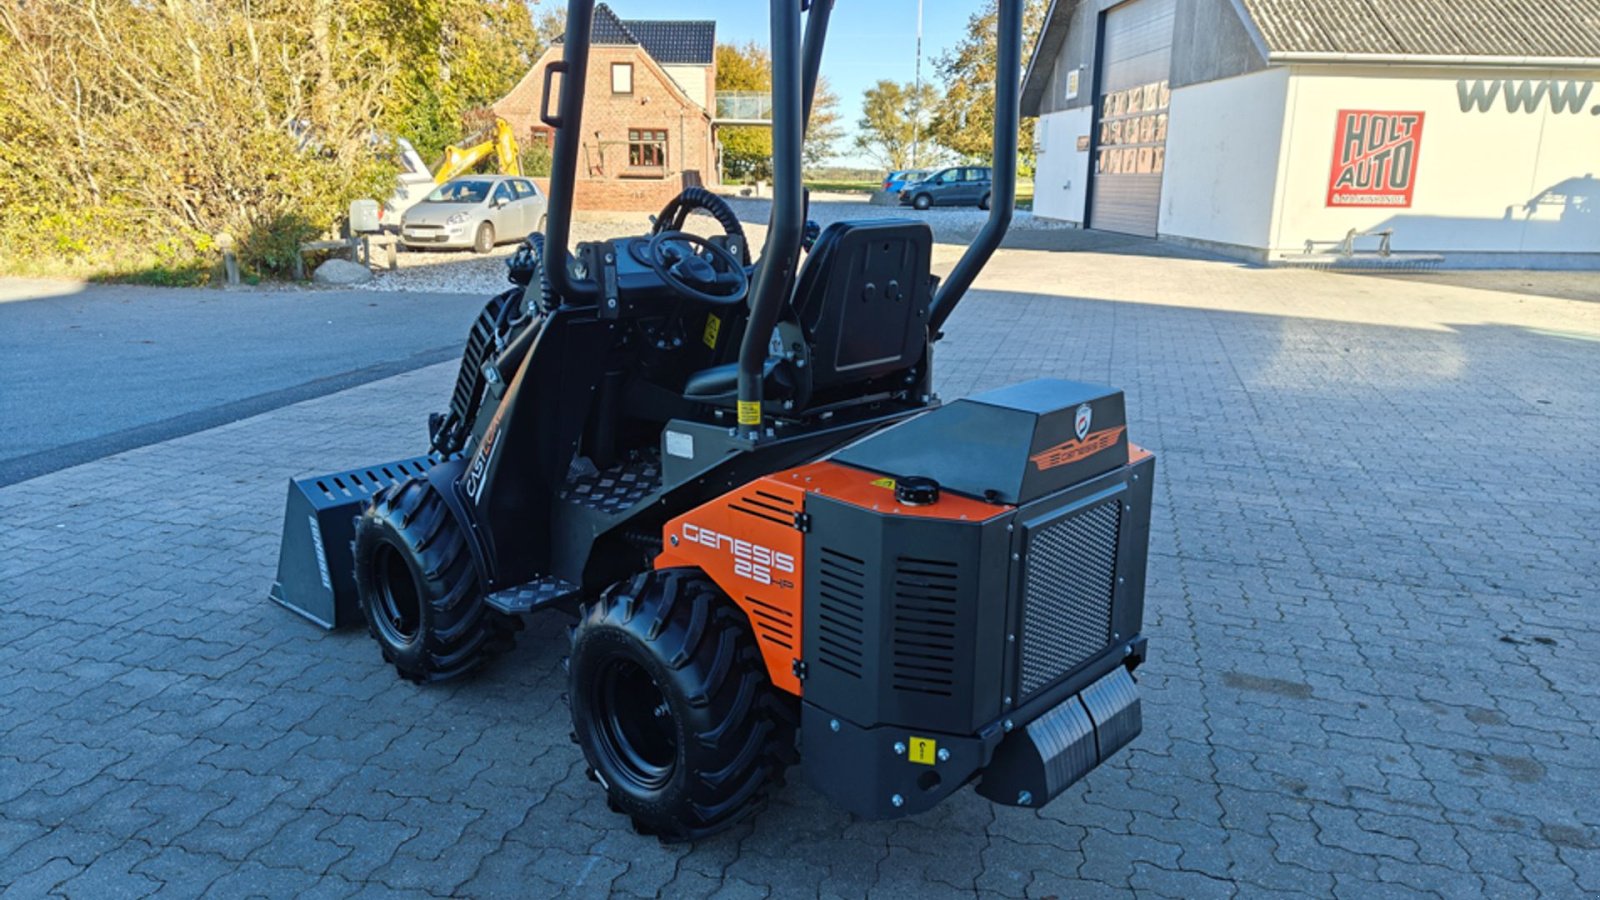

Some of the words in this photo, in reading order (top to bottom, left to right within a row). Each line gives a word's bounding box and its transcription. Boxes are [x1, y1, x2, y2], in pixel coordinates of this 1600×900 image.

[1334, 139, 1414, 190] AUTO
[1341, 114, 1418, 166] HOLT
[682, 522, 795, 573] GENESIS
[734, 557, 772, 585] 25
